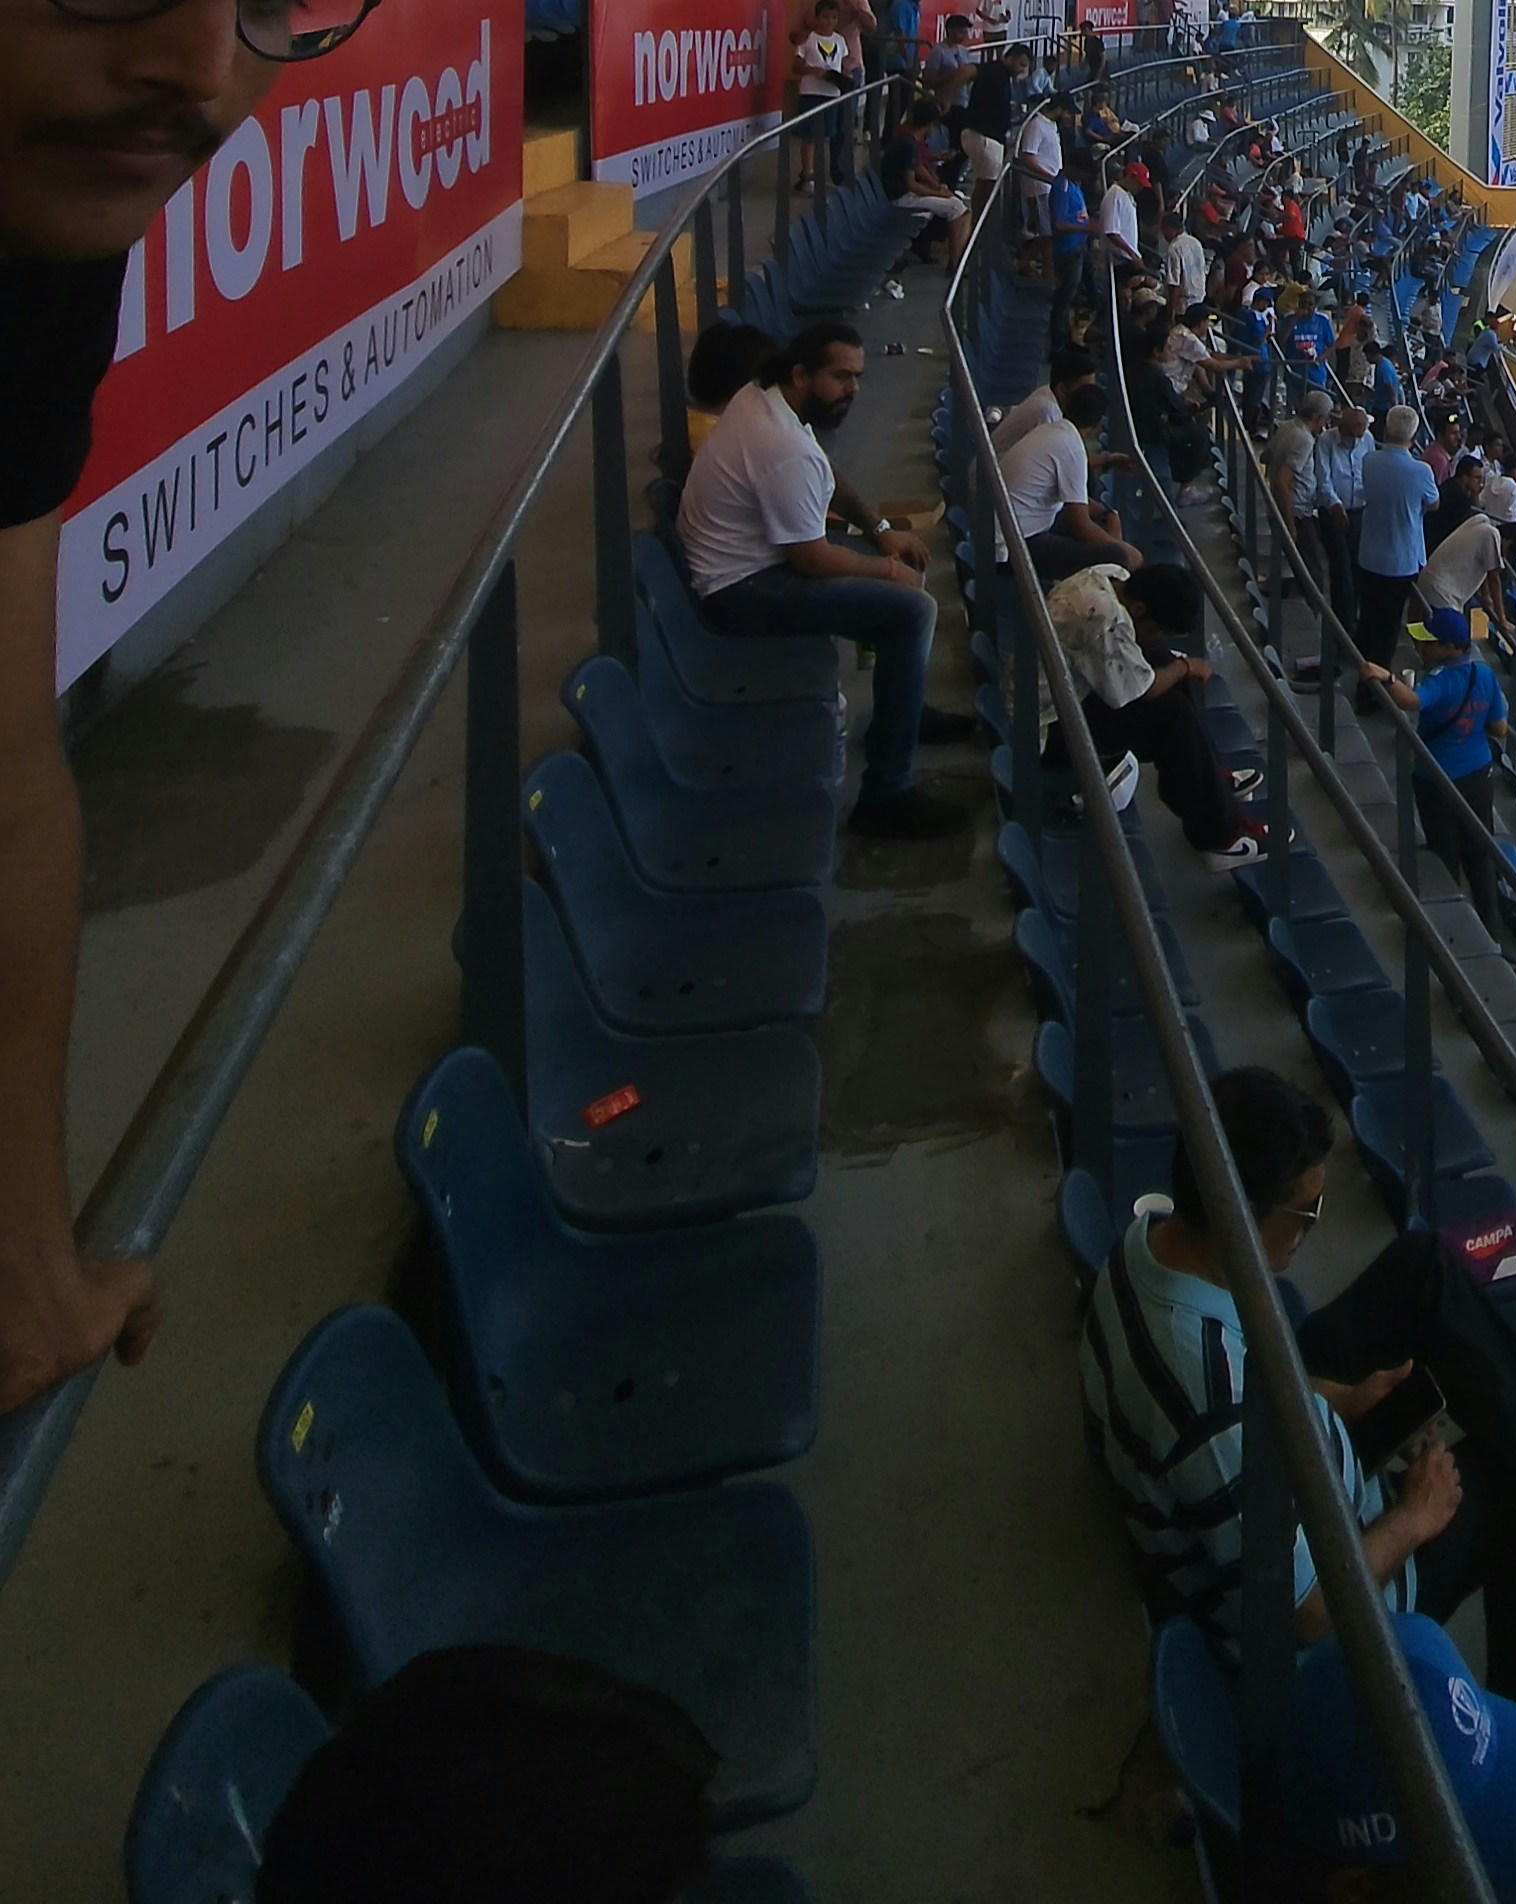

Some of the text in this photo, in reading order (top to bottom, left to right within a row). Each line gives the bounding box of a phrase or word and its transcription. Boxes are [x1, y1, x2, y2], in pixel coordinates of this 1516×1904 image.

[1086, 7, 1128, 27] norwood
[634, 10, 767, 106] norwood
[631, 143, 697, 188] SWITCHES
[100, 237, 495, 606] SWITCHES & AUTOMATION
[1466, 1222, 1515, 1254] CAMPA
[1337, 1811, 1397, 1850] IND
